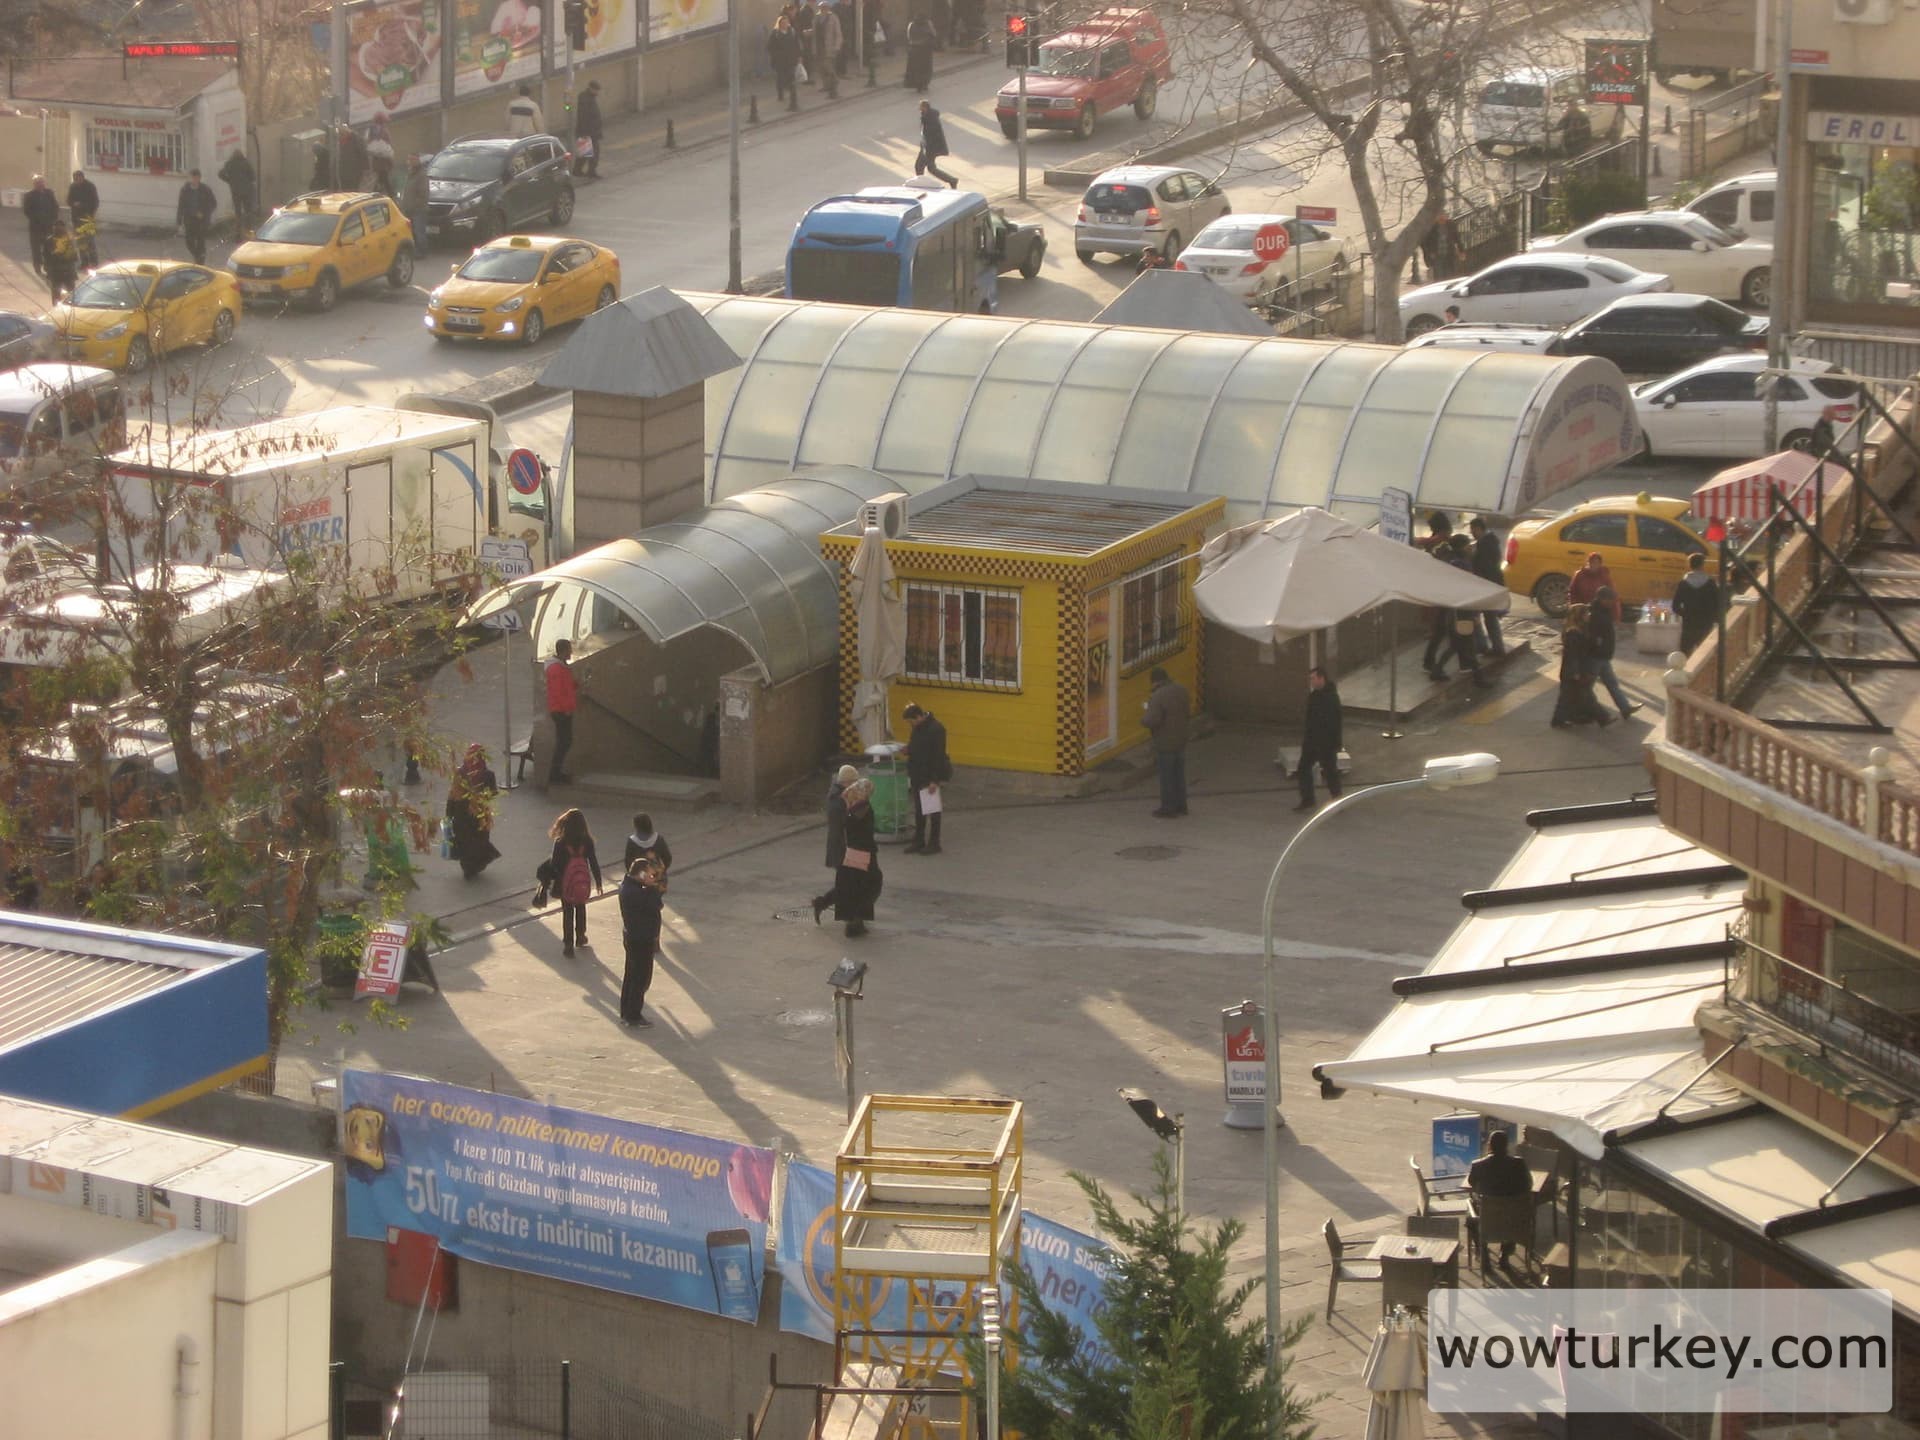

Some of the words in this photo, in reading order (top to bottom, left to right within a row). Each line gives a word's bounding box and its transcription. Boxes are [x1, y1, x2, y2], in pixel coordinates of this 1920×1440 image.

[1825, 118, 1906, 141] EROL
[1256, 235, 1286, 251] DUR
[371, 949, 393, 975] E
[391, 1092, 426, 1115] her
[430, 1099, 494, 1129] açıdan
[496, 1113, 610, 1153] mükemmel
[610, 1135, 721, 1180] kampanya
[463, 1140, 487, 1161] kere
[491, 1146, 511, 1167] 100
[515, 1150, 544, 1173] TL'lik
[548, 1160, 576, 1181] yakıt
[579, 1165, 661, 1198] alışverişinize,
[465, 1166, 495, 1188] Kredi
[499, 1171, 541, 1197] Cüzdan
[543, 1185, 627, 1217] uygulamasıyla
[466, 1201, 529, 1239] ekstre
[536, 1213, 614, 1257] indirimi
[621, 1231, 703, 1276] kazanın.
[1040, 1265, 1088, 1308] her
